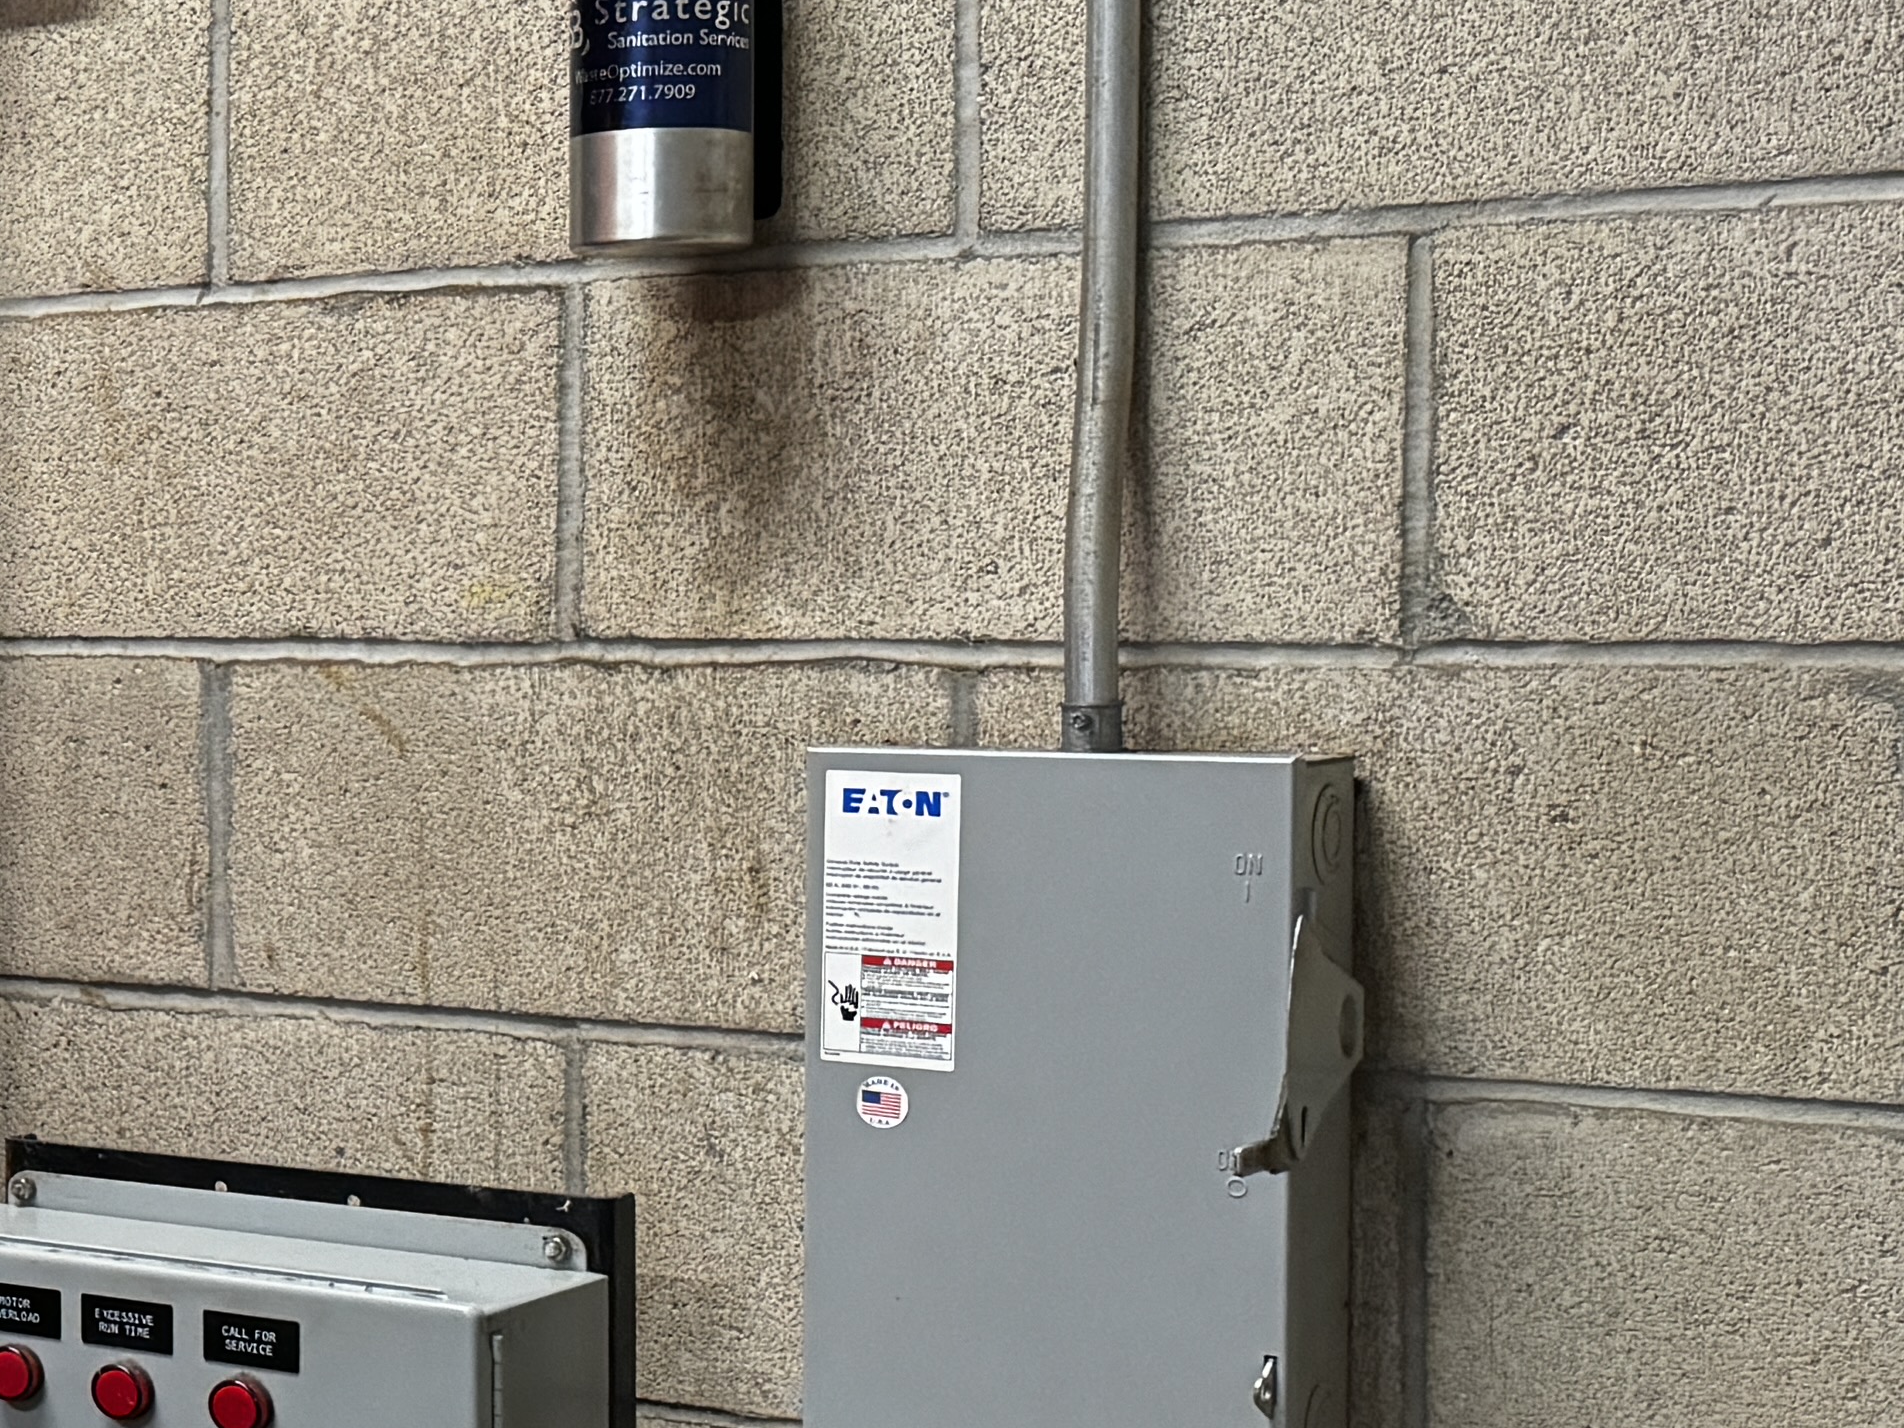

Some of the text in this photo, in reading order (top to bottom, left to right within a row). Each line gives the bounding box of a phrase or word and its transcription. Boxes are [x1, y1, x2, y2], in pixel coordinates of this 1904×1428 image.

[607, 29, 749, 49] Sanitation Services
[842, 788, 942, 817] EATON
[893, 958, 937, 969] DANGER
[893, 1020, 938, 1032] PELIGRO
[94, 1307, 154, 1327] EXCESSIVE
[98, 1322, 150, 1339] RUN TIME
[221, 1325, 277, 1343] CALL FOR
[225, 1339, 273, 1356] SERVICE
